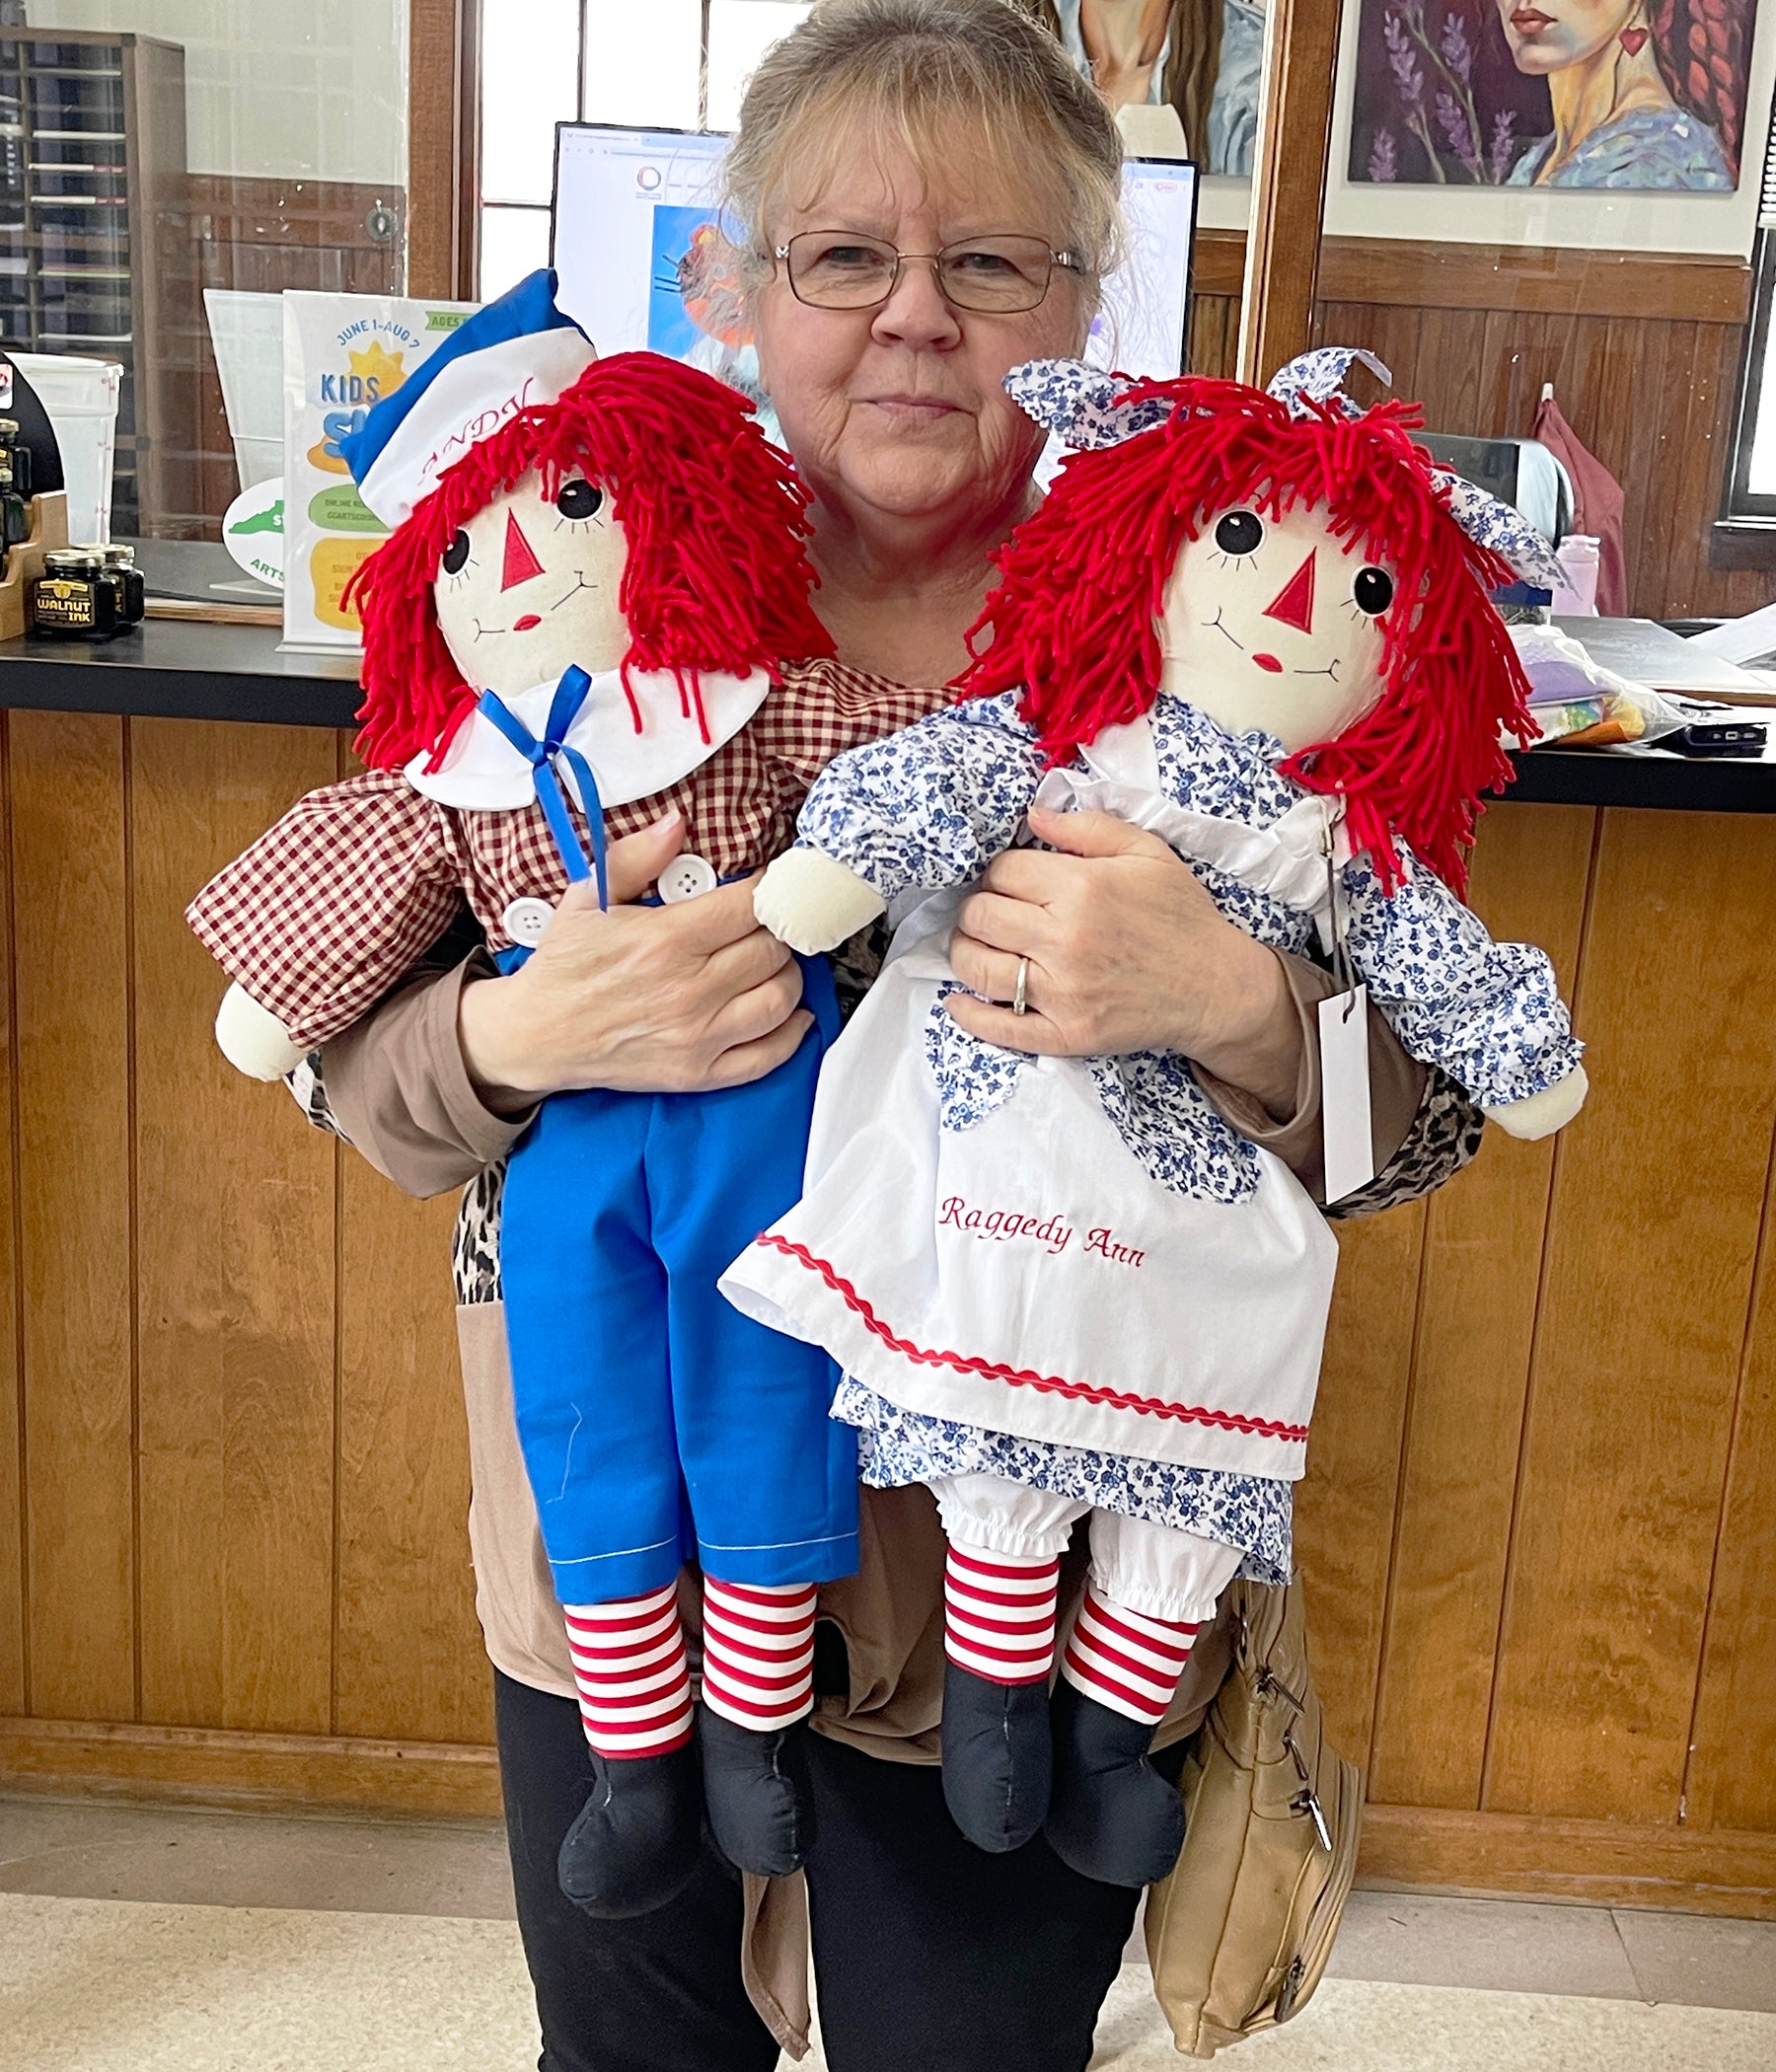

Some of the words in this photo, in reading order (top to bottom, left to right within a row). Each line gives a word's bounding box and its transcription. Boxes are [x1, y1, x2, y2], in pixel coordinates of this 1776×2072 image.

[336, 320, 369, 346] JUNE
[431, 317, 460, 328] AGES
[321, 373, 381, 405] KIDS
[250, 558, 284, 582] ARTS
[37, 598, 91, 612] WALNUT
[68, 612, 91, 623] INK
[938, 1196, 1073, 1254] Raggedy
[1083, 1227, 1146, 1268] Ann
